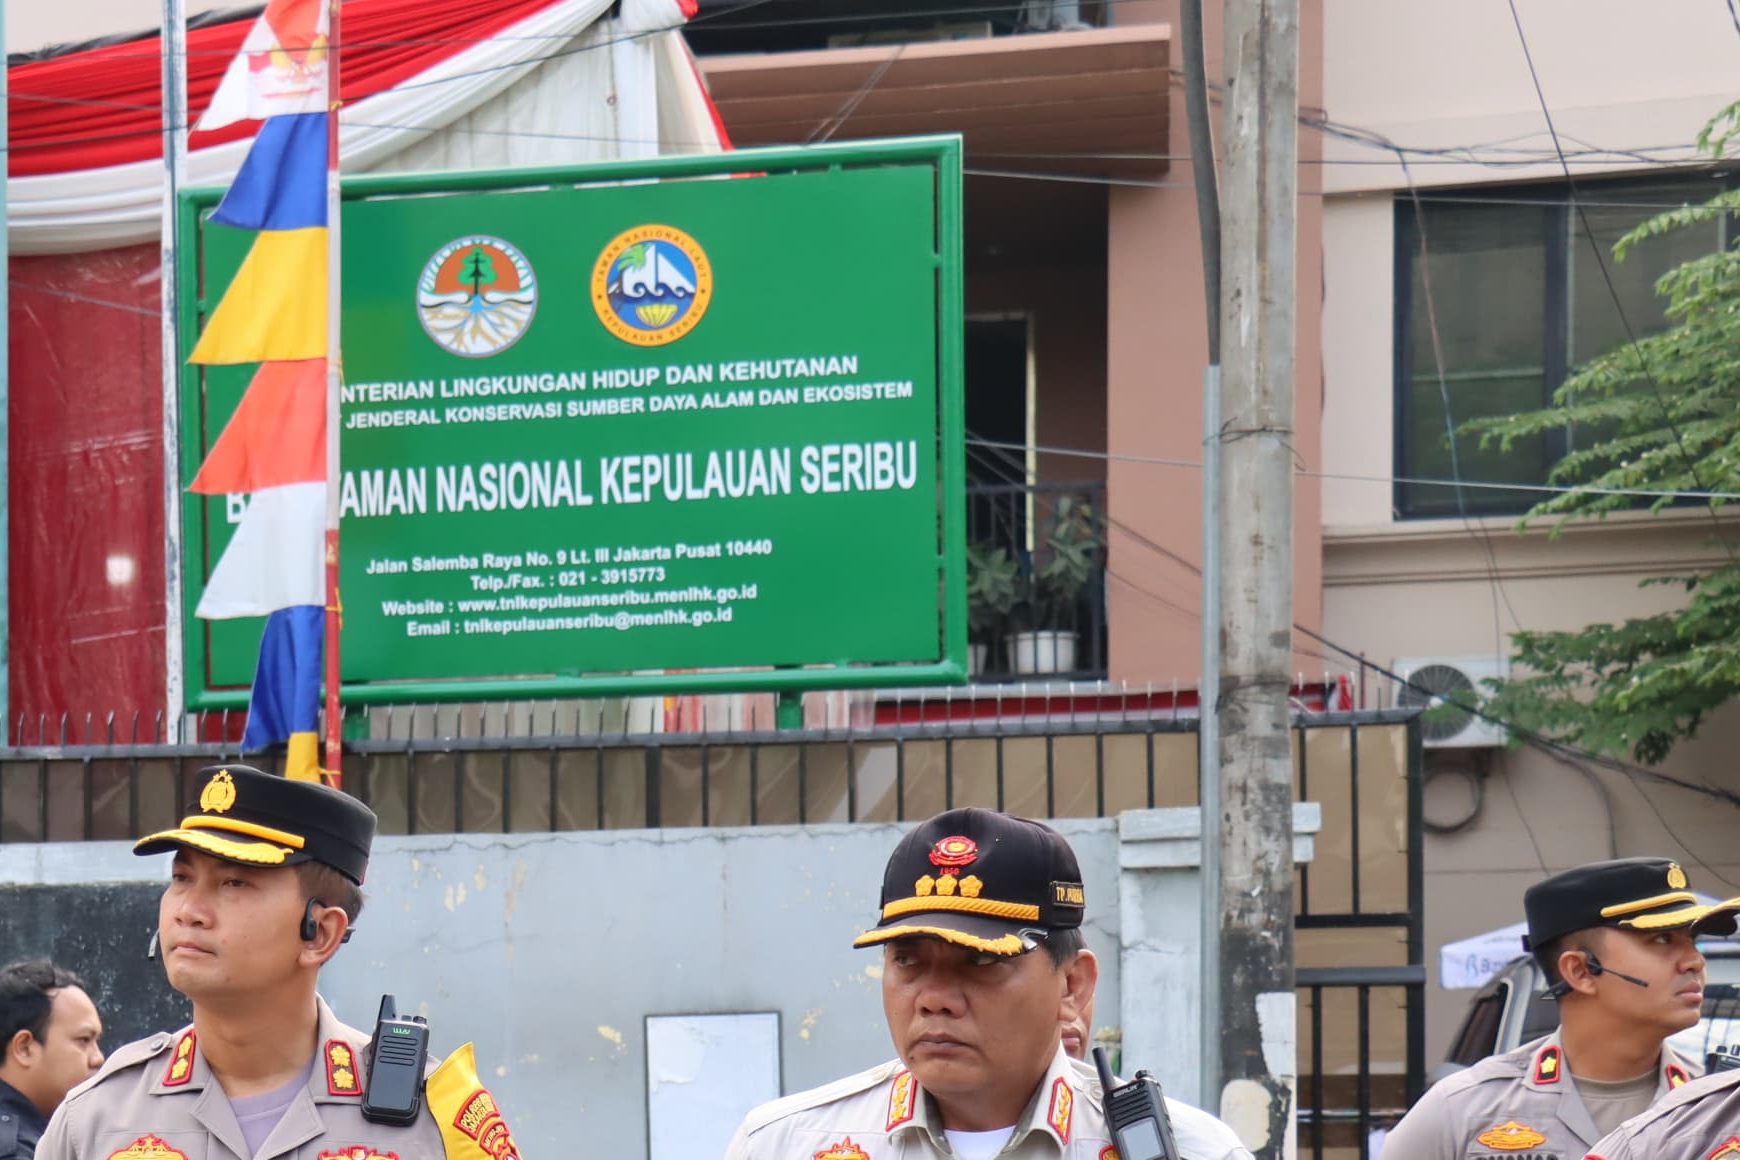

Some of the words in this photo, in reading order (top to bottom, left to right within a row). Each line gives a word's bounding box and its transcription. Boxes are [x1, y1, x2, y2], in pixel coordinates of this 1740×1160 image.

[341, 380, 434, 403] NTERIAN
[440, 372, 587, 398] LINGKUNGAN
[592, 367, 660, 390] HIDUP
[665, 363, 712, 385] DAN
[720, 355, 858, 381] KEHUTANAN
[346, 408, 441, 429] JENDERAL
[445, 404, 562, 424] KONSERVASI
[567, 396, 645, 417] SUMBER
[649, 393, 698, 412] DAYA
[701, 390, 754, 409] ALAM
[758, 388, 799, 407] DAN
[803, 381, 913, 404] EKOSISTEM
[340, 467, 427, 519] AMAN
[436, 459, 593, 512] NASIONAL
[600, 447, 791, 505] KEPULAUAN
[801, 440, 917, 494] SERIBU
[366, 558, 408, 575] Jalan
[412, 554, 478, 572] Salemba
[482, 552, 522, 571] Raya
[526, 551, 553, 566] No.
[556, 550, 566, 565] 9
[570, 549, 591, 565] Lt.
[595, 548, 609, 563] III
[613, 546, 671, 563] Jakarta
[675, 543, 721, 559] Pusat
[725, 539, 772, 556] 10440
[470, 573, 545, 592] Telp./Fax.
[559, 571, 585, 586] 021
[601, 566, 665, 585] 3915773
[382, 600, 444, 616] Website
[407, 620, 450, 637] Email
